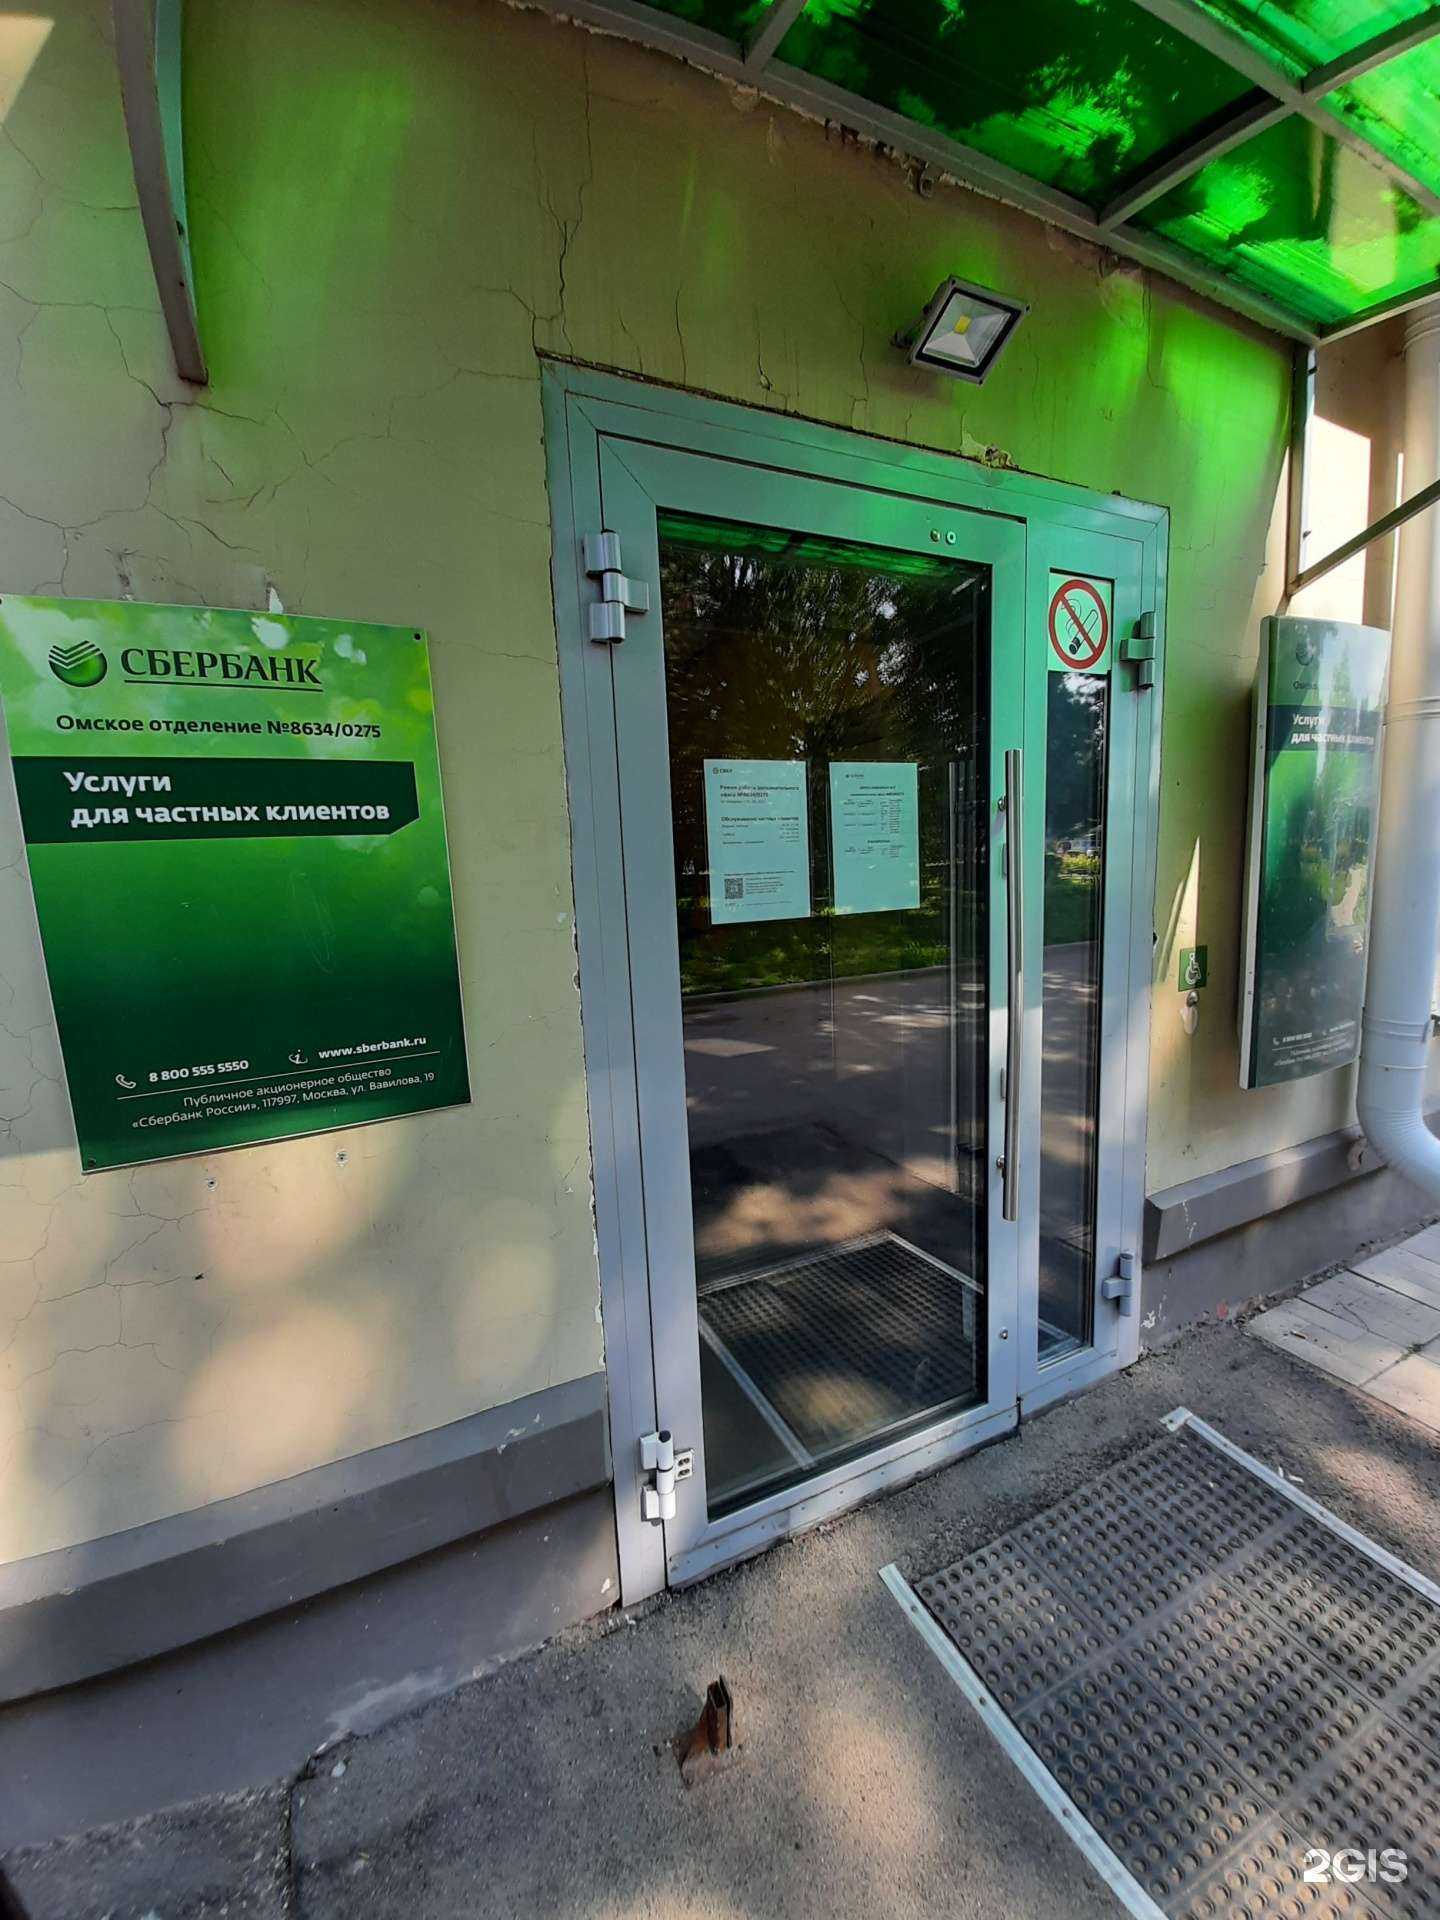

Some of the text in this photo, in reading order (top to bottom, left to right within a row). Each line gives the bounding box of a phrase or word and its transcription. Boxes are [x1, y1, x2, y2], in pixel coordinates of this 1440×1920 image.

[121, 648, 322, 685] СБЕРБАНК
[56, 714, 381, 739] Омское отделение №8634/0275
[62, 771, 172, 798] Услуги
[71, 805, 391, 828] для частных клиентов
[318, 1036, 427, 1059] www.sberbank.ru
[149, 1059, 249, 1082] 8 800 555 5550
[132, 1109, 203, 1128] «Сбербанк
[206, 1102, 260, 1117] России»,
[302, 1085, 349, 1101] Москва,
[369, 1074, 423, 1091] Вавилова,
[425, 1072, 435, 1082] 19
[183, 1068, 392, 1107] Публичное акционерное общество
